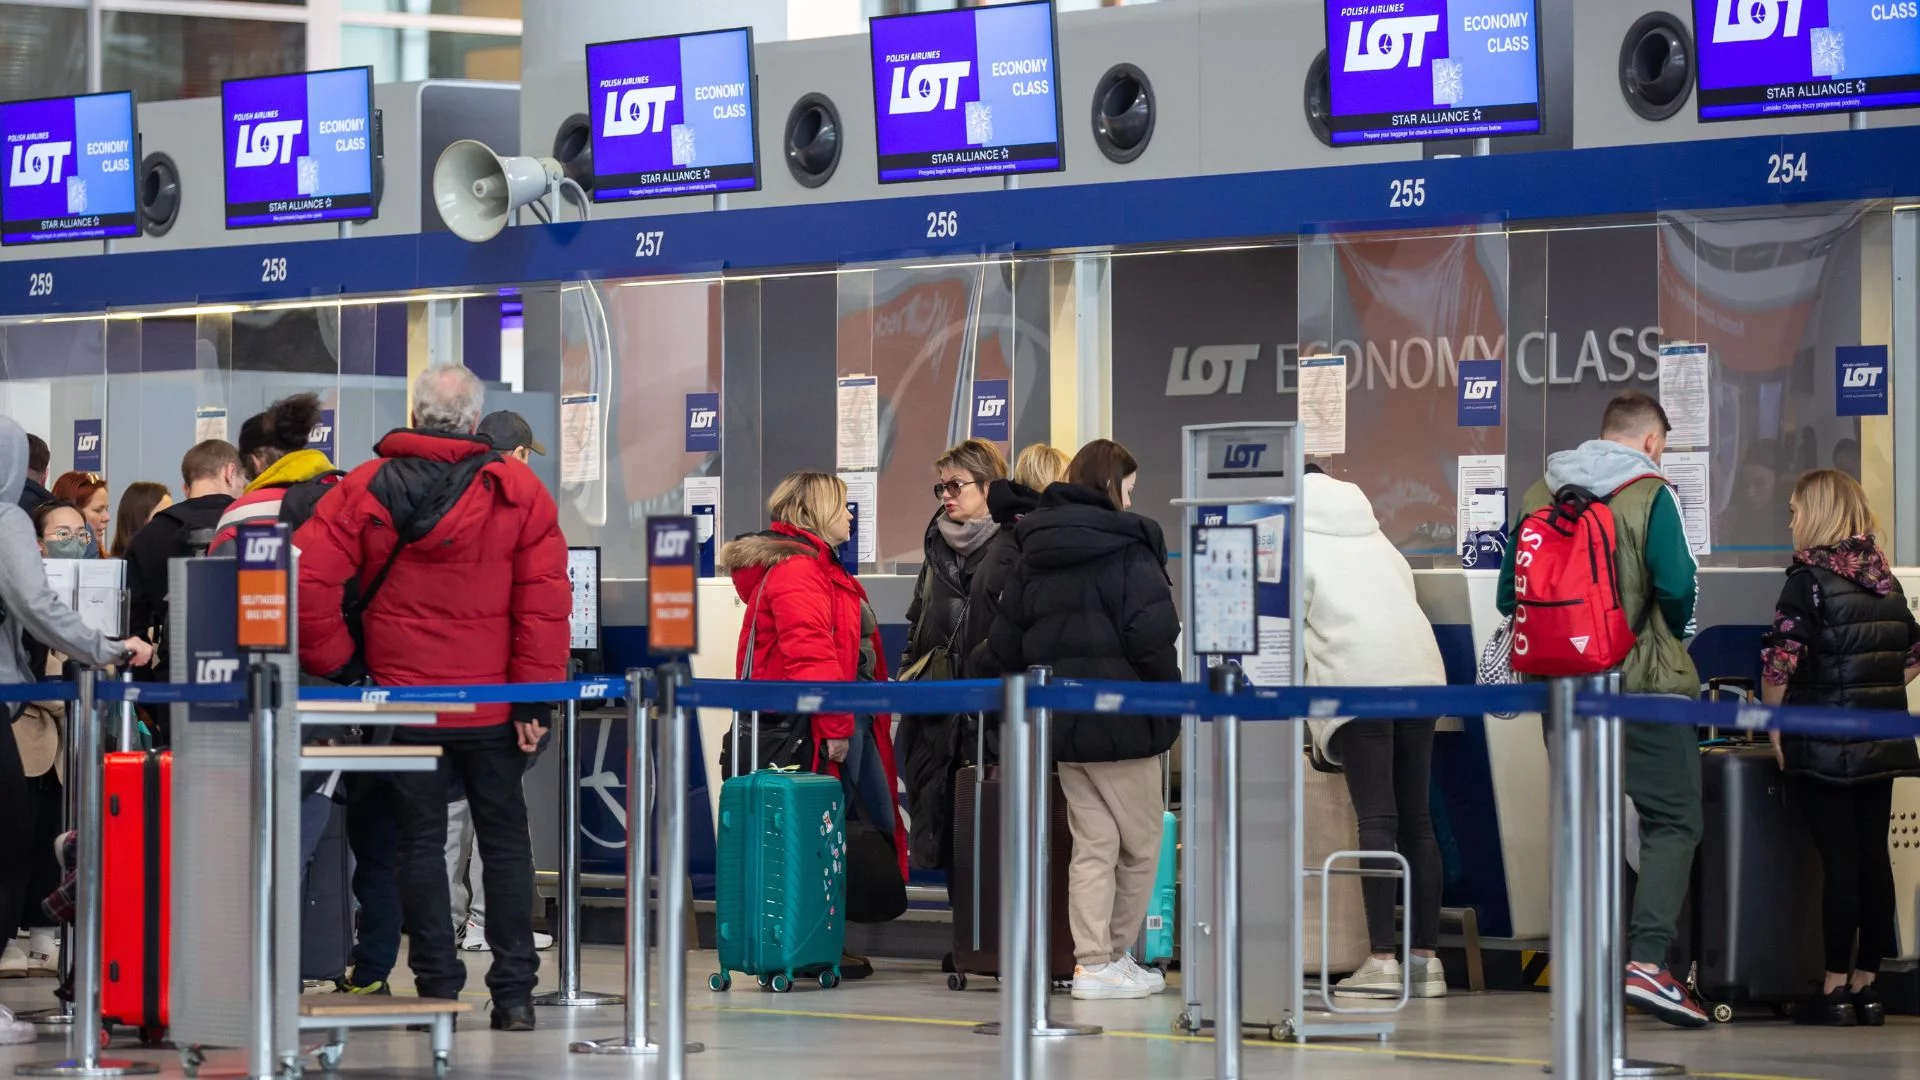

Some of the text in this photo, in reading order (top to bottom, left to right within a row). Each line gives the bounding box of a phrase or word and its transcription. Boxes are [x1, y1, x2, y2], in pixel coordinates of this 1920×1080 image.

[1341, 3, 1404, 16] POLISH AIRLINES
[1871, 2, 1918, 20] CLASS
[1464, 12, 1529, 32] ECONOMY
[1343, 14, 1439, 73] LOT
[1487, 35, 1529, 53] CLASS
[886, 50, 940, 63] POLISH AIRLINES
[992, 58, 1048, 77] ECONOMY
[600, 75, 649, 88] POLISH AIRLINES
[888, 61, 971, 115] LOT
[1012, 80, 1049, 97] CLASS
[695, 83, 745, 101] ECONOMY
[1766, 83, 1853, 100] STAR ALLIANCE
[602, 85, 676, 137] LOT
[713, 104, 746, 119] CLASS
[1392, 110, 1470, 126] STAR ALLIANCE
[319, 118, 365, 134] ECONOMY
[87, 140, 129, 155] ECONOMY
[235, 119, 303, 168] LOT
[335, 138, 365, 152] CLASS
[10, 141, 72, 187] LOT
[102, 158, 130, 172] CLASS
[931, 149, 999, 164] STAR ALLIANCE
[641, 169, 701, 184] STAR ALLIANCE
[1767, 152, 1808, 184] 254
[1389, 178, 1425, 208] 255
[269, 198, 324, 213] STAR ALLIANCE
[41, 216, 93, 230] STAR ALLIANCE
[926, 211, 958, 238] 256
[635, 231, 664, 257] 257
[262, 257, 287, 282] 258
[29, 272, 53, 296] 259
[1165, 325, 1664, 397] LOT EONOMY CLASS
[1843, 366, 1883, 387] LOT
[1464, 380, 1498, 399] LOT
[977, 399, 1006, 417] LOT
[690, 411, 717, 428] LOT
[77, 435, 99, 451] LOT
[1223, 443, 1267, 469] LOT
[244, 537, 283, 562] LOT
[654, 529, 691, 557] LOT
[1514, 527, 1543, 656] GUESS
[196, 659, 240, 684] LOT
[580, 683, 609, 698] LOT
